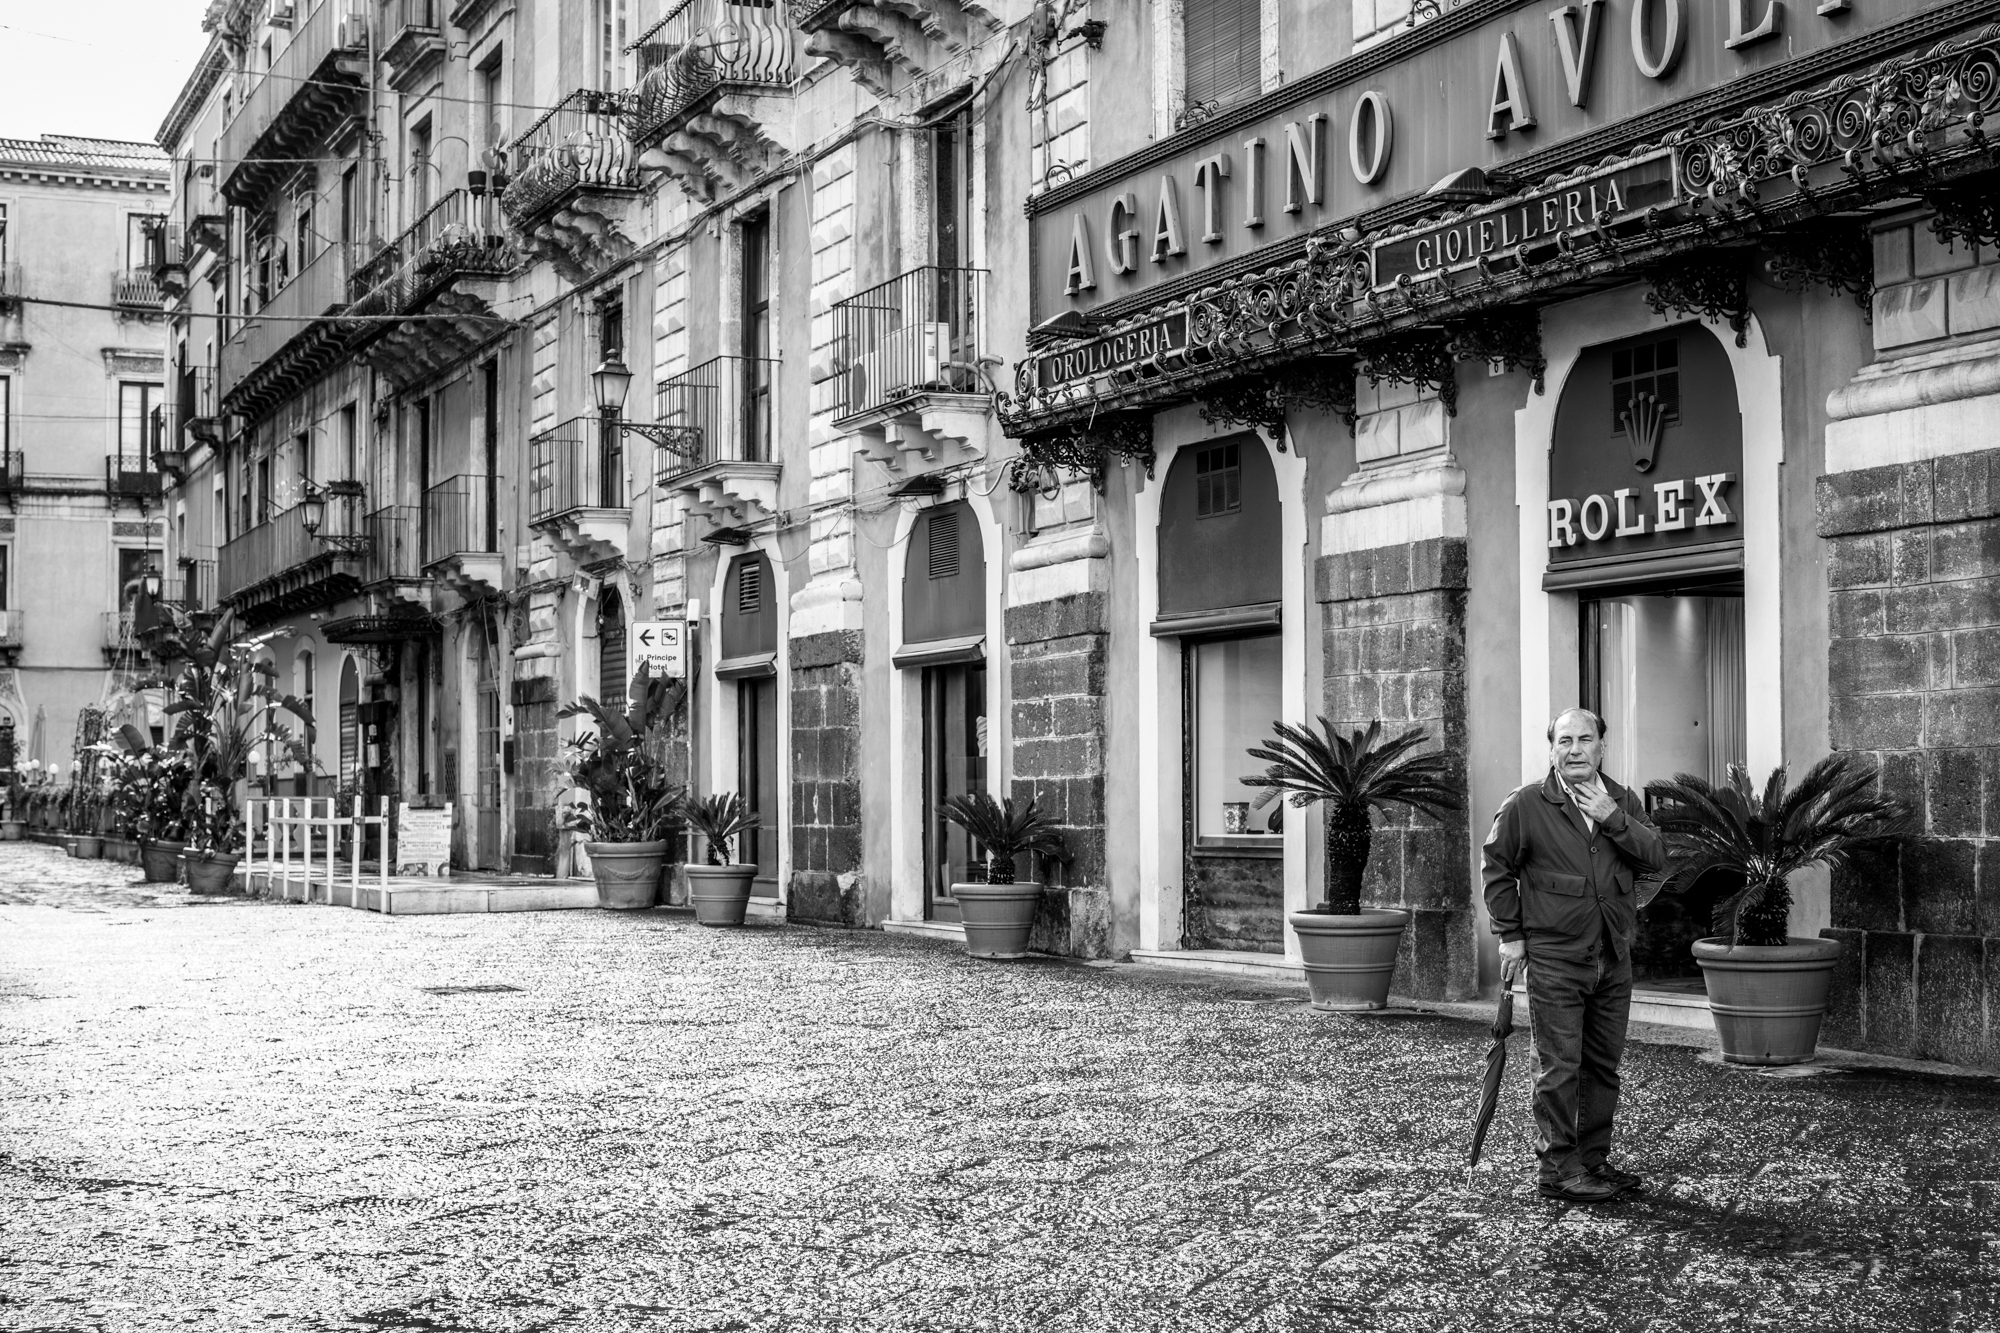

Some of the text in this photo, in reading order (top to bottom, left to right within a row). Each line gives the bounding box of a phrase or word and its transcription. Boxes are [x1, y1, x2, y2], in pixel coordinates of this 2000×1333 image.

[1063, 90, 1393, 296] AGATINO
[1415, 178, 1626, 271] GIOIELLERIA
[1051, 323, 1173, 384] OROLOGERIA
[1548, 472, 1737, 548] ROLEX
[646, 654, 677, 662] Principe
